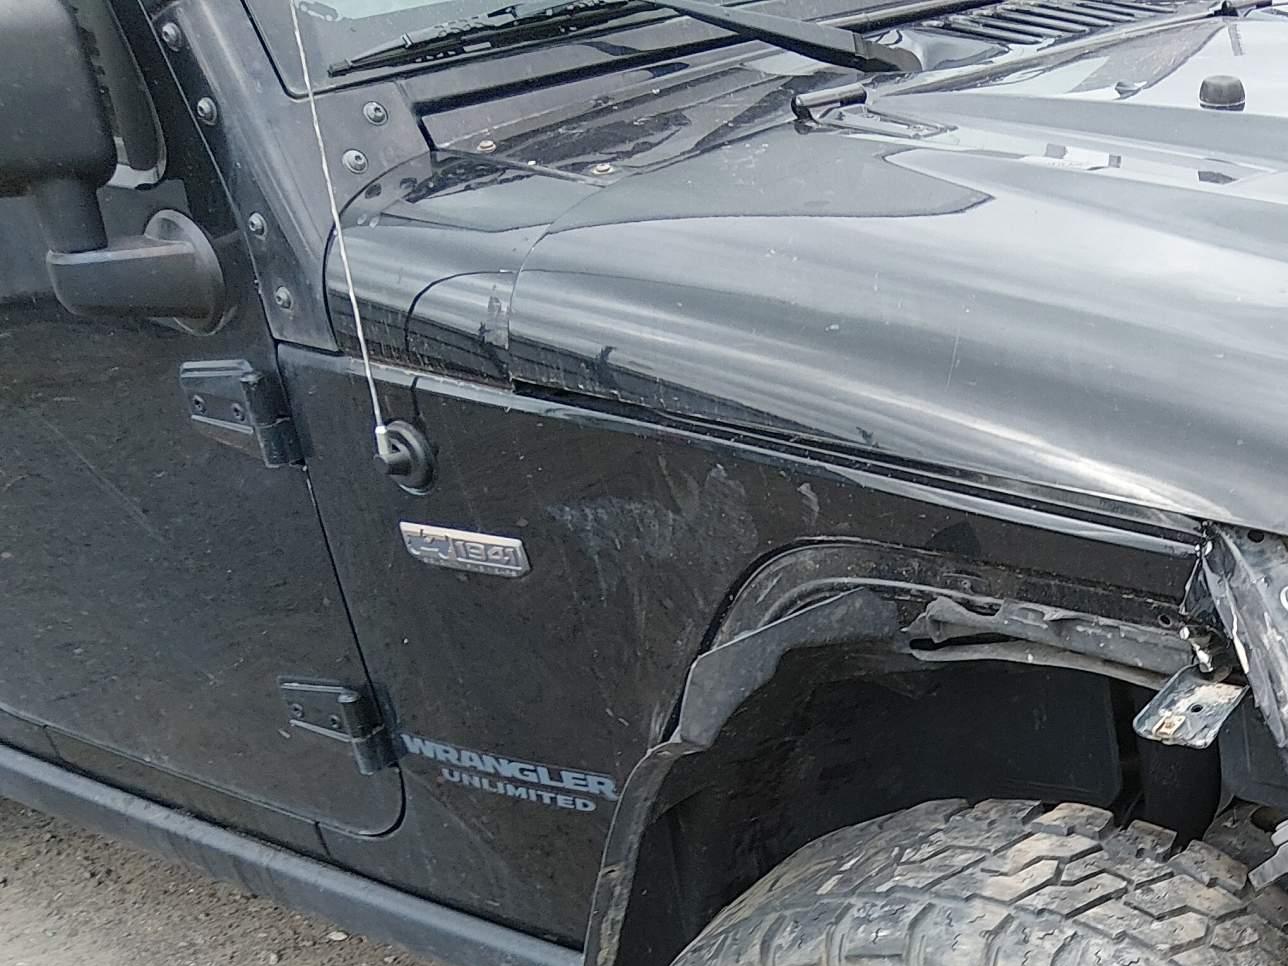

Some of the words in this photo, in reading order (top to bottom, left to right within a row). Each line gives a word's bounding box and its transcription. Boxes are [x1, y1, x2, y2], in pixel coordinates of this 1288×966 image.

[454, 541, 519, 566] 1941
[402, 733, 618, 800] WRANGLER
[441, 767, 596, 812] UNLIMITED
